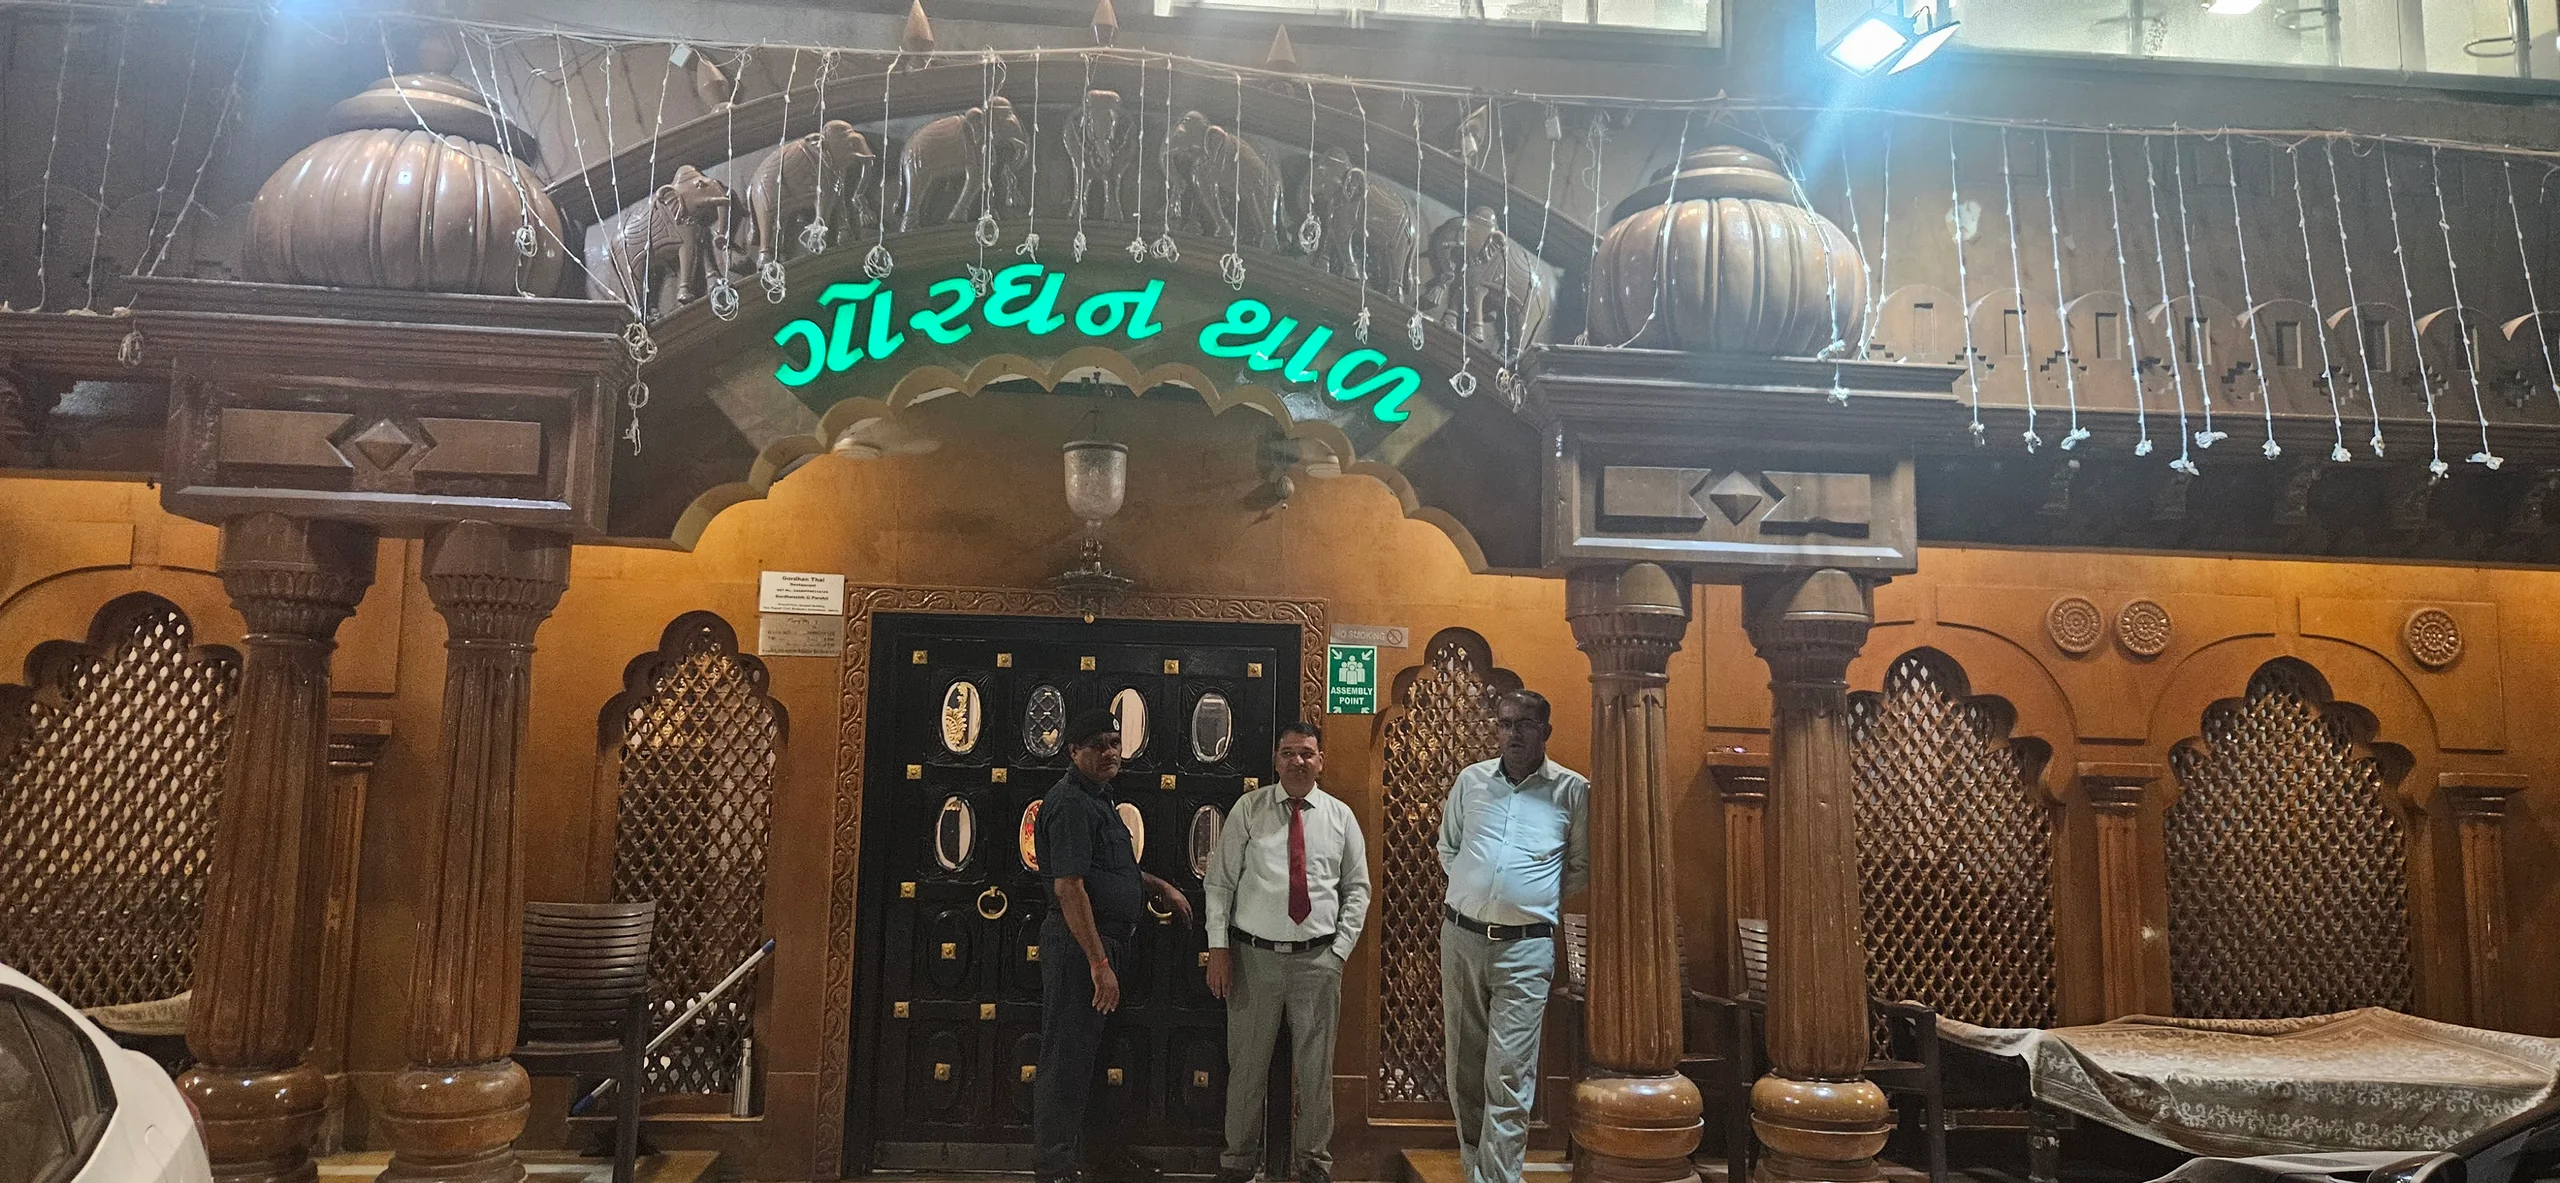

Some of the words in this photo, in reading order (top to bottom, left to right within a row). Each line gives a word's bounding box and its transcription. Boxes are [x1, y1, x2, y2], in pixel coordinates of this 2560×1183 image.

[774, 263, 1164, 386] ગોરધન
[1198, 299, 1420, 422] થાળ
[1335, 629, 1347, 638] NO
[1348, 630, 1386, 641] SMOKING
[1330, 686, 1373, 696] ASSEMBLY
[1339, 696, 1365, 705] POINT
